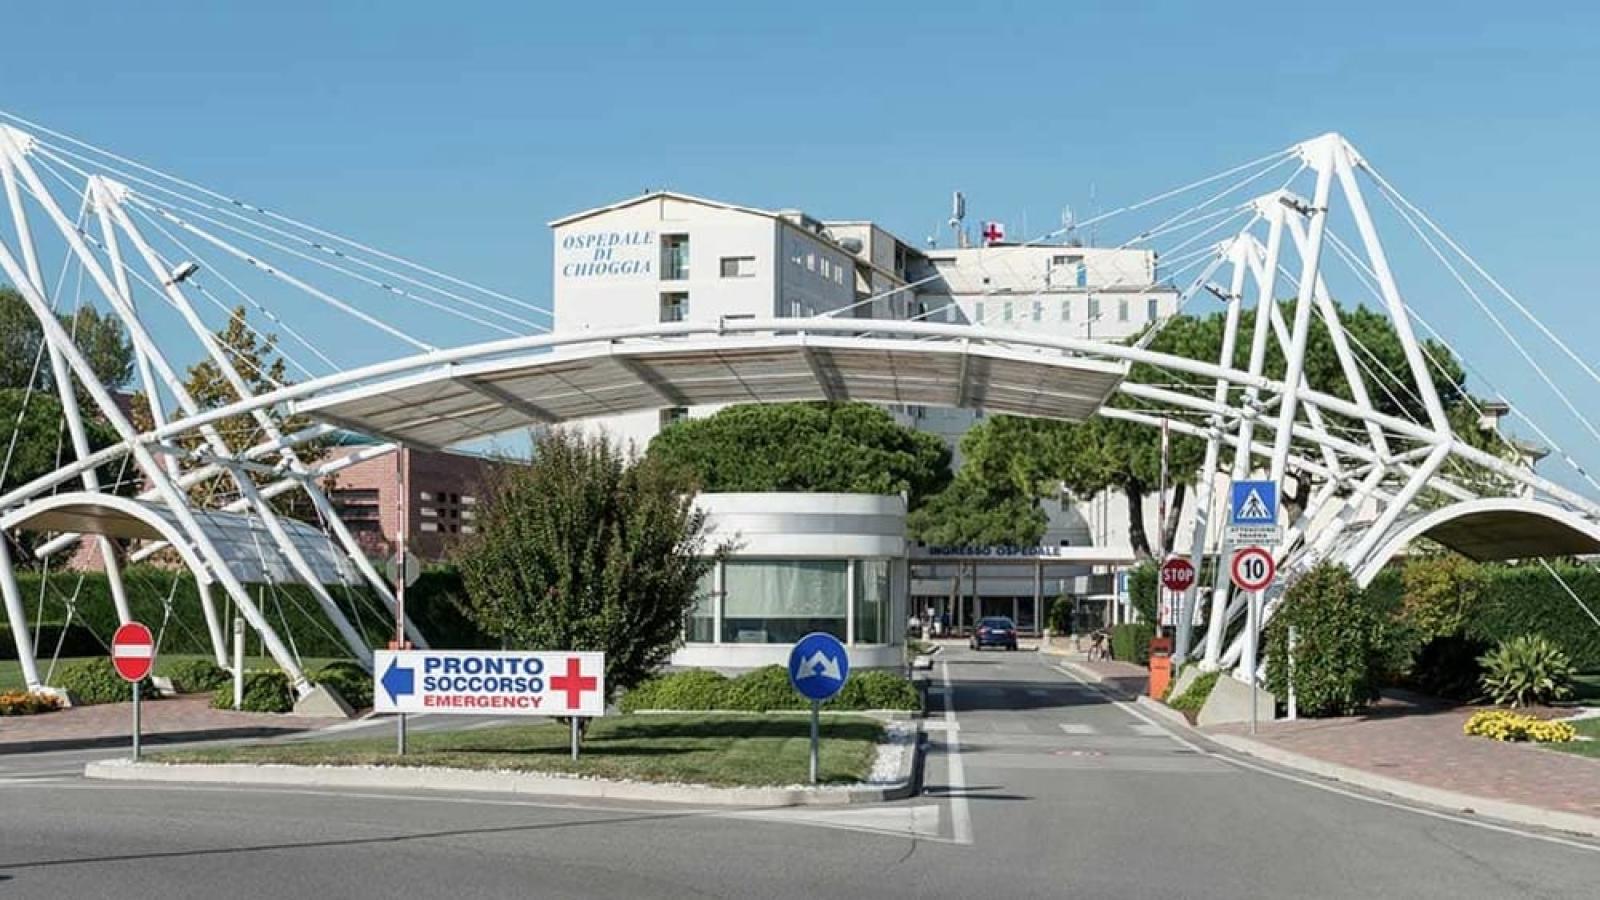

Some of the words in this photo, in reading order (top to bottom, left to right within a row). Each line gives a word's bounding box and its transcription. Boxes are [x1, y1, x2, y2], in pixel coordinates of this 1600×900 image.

[563, 231, 653, 249] OSPEDALE
[594, 248, 612, 261] DI
[563, 260, 650, 277] CHIOGGIA
[1164, 567, 1193, 582] STOP
[1244, 559, 1265, 579] 10
[423, 657, 544, 675] PRONTO
[423, 676, 544, 693] SOCCORSO
[423, 695, 543, 708] EMERGENCY
